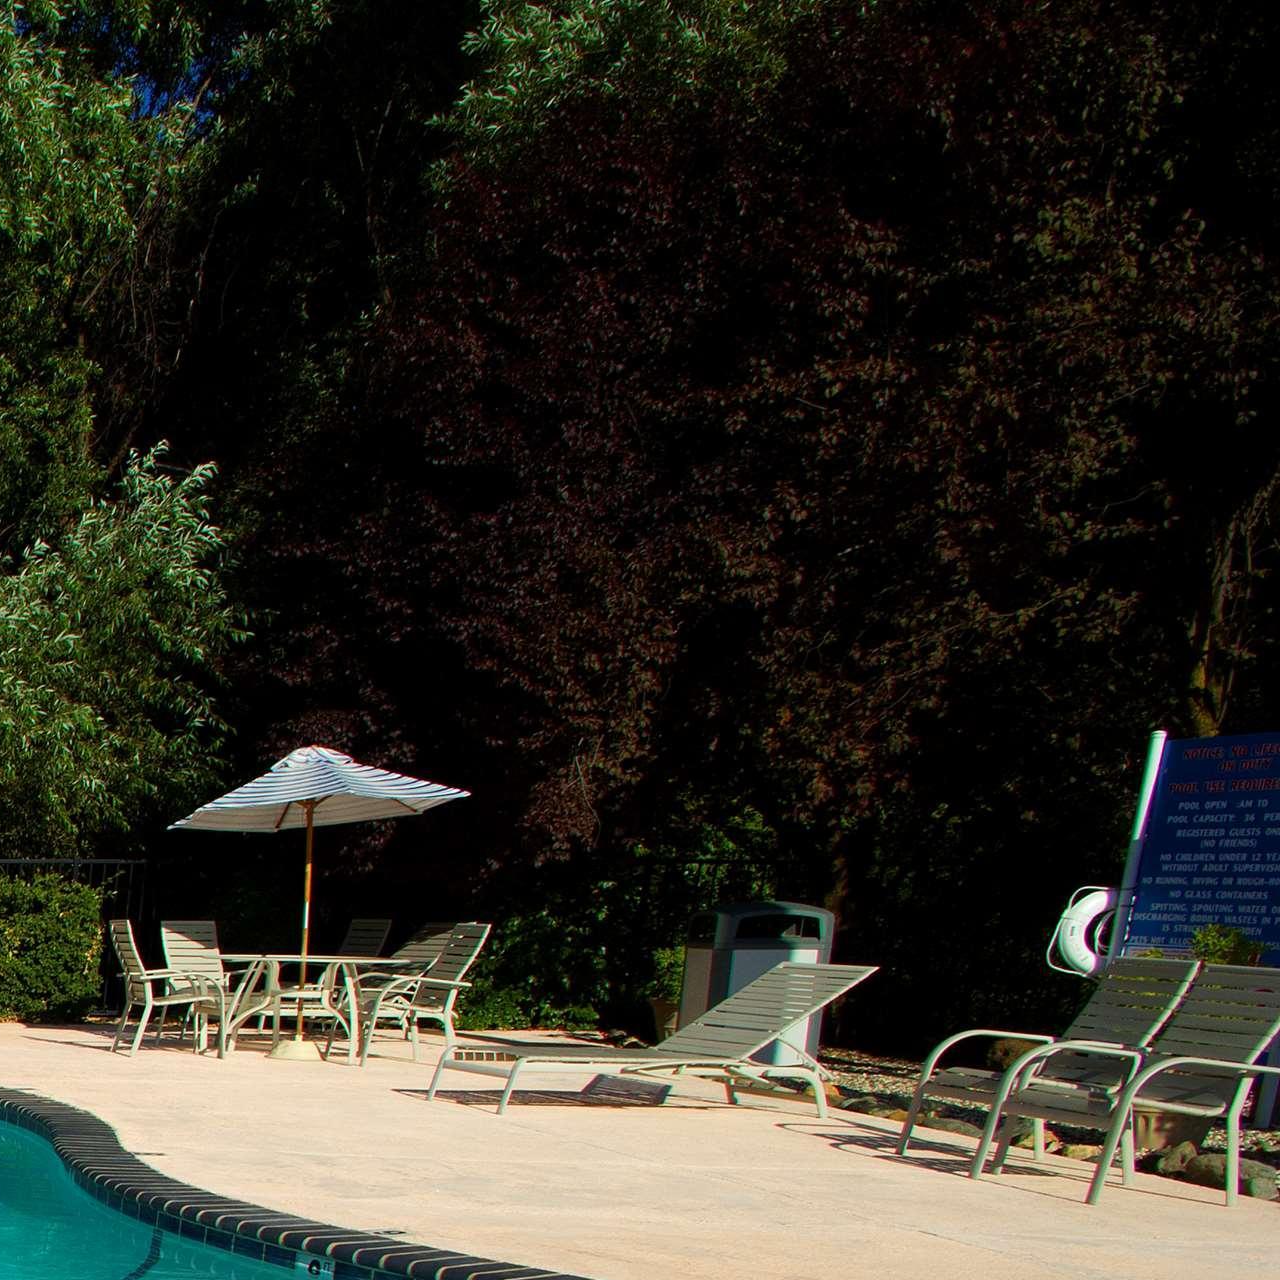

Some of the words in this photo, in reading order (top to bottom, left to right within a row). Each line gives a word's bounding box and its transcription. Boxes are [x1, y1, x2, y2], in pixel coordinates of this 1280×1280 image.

[1179, 801, 1200, 810] POOL
[1205, 800, 1227, 809] OPEN
[1167, 815, 1189, 824] POOL
[1176, 829, 1225, 838] REGISTERED
[1229, 828, 1260, 837] GUESTS
[1160, 853, 1172, 861] NO
[1176, 853, 1216, 861] CHILDREN
[1218, 853, 1248, 861] UNDER
[1162, 863, 1198, 872] WITHOUT
[1202, 863, 1229, 872] ADULT
[1184, 890, 1212, 899] GLASS
[1215, 890, 1269, 900] CONTAINERS
[1238, 905, 1267, 914] WATER
[1133, 912, 1187, 921] DISCHARGING
[1224, 915, 1257, 924] WASTES
